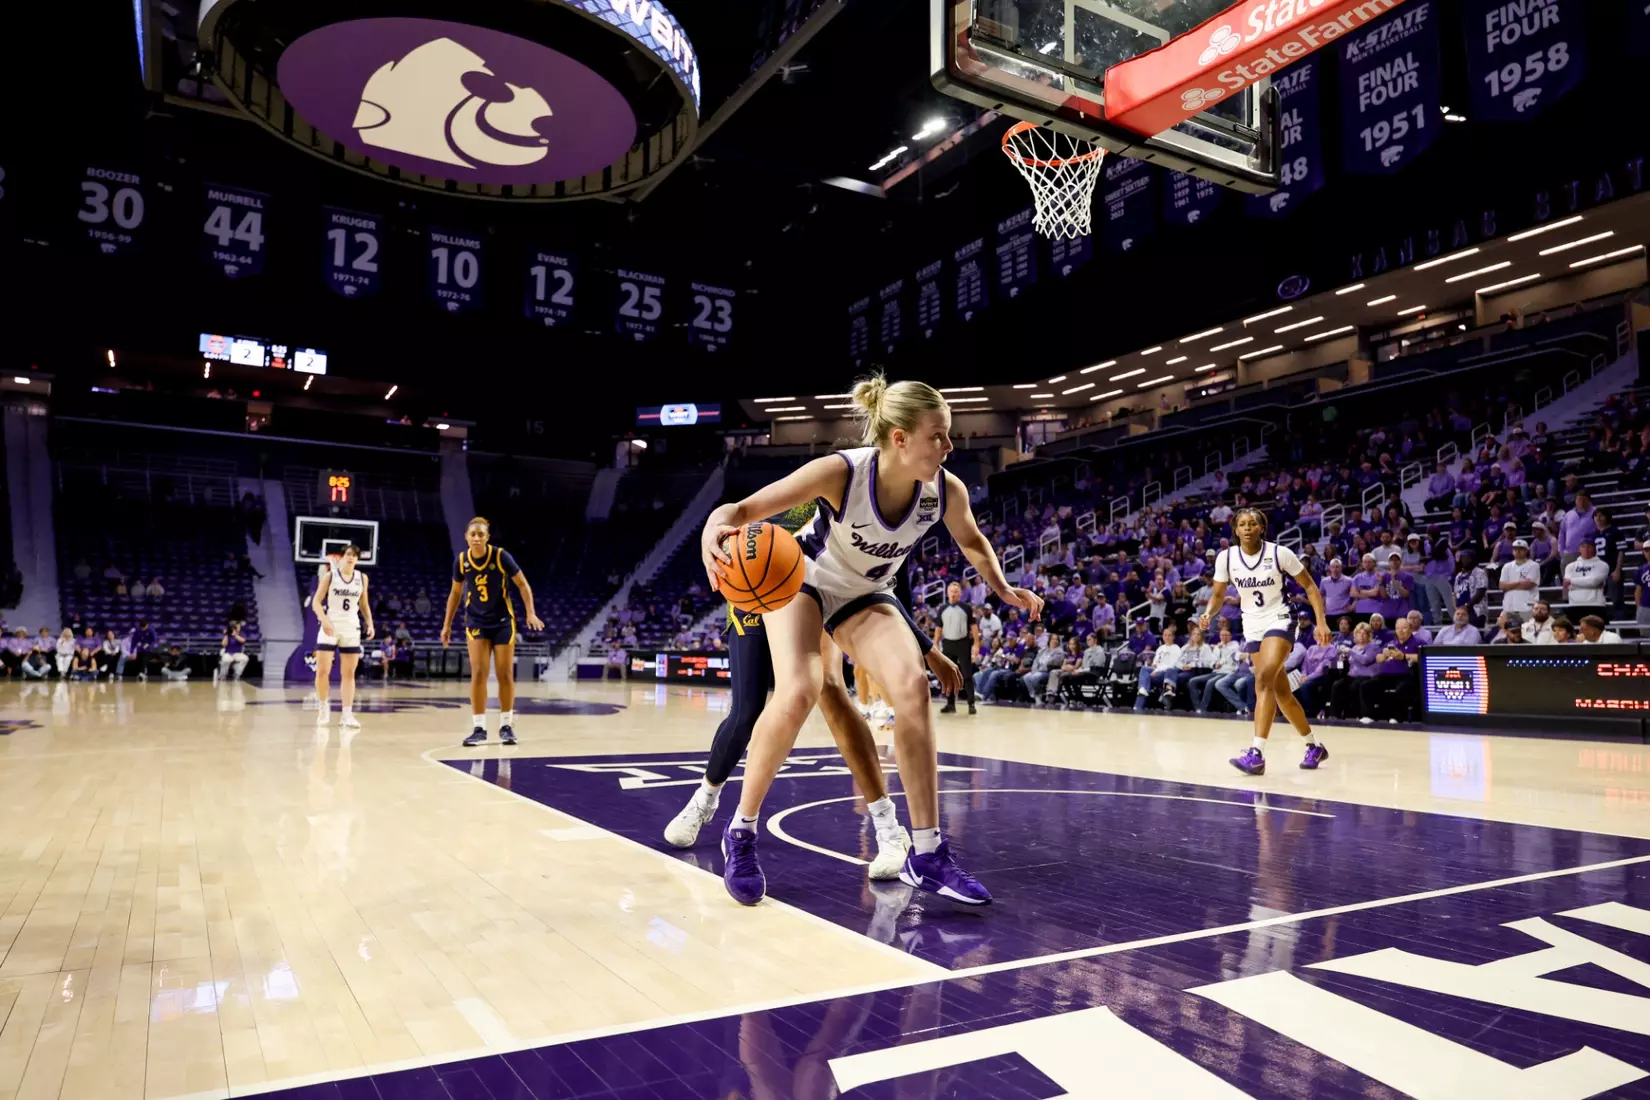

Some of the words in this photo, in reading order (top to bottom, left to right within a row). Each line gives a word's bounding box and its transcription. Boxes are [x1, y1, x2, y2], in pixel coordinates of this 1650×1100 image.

[1486, 4, 1560, 54] FOUR
[1358, 51, 1420, 94] FINAL
[1484, 41, 1570, 98] 1958
[1359, 70, 1420, 113] FOUR
[1360, 102, 1425, 152] 1951
[86, 167, 140, 185] BOOZER
[77, 180, 145, 230] 30
[208, 189, 264, 209] MURRELL
[203, 205, 265, 252] 44
[331, 213, 376, 230] KRUGER
[327, 228, 379, 273] 12
[430, 232, 481, 250] WILLIAMS
[431, 247, 479, 289] 10
[537, 252, 569, 266] EVANS
[530, 265, 574, 306] 12
[617, 268, 666, 285] BLACKMAN
[619, 281, 663, 321] 25
[692, 294, 733, 333] 23
[244, 348, 251, 359] 2
[307, 356, 314, 367] 2
[332, 487, 347, 502] 17
[1235, 577, 1275, 588] Wildcats
[477, 585, 488, 602] 3
[1252, 590, 1264, 607] 3
[343, 598, 350, 611] 6
[743, 614, 760, 627] Cal
